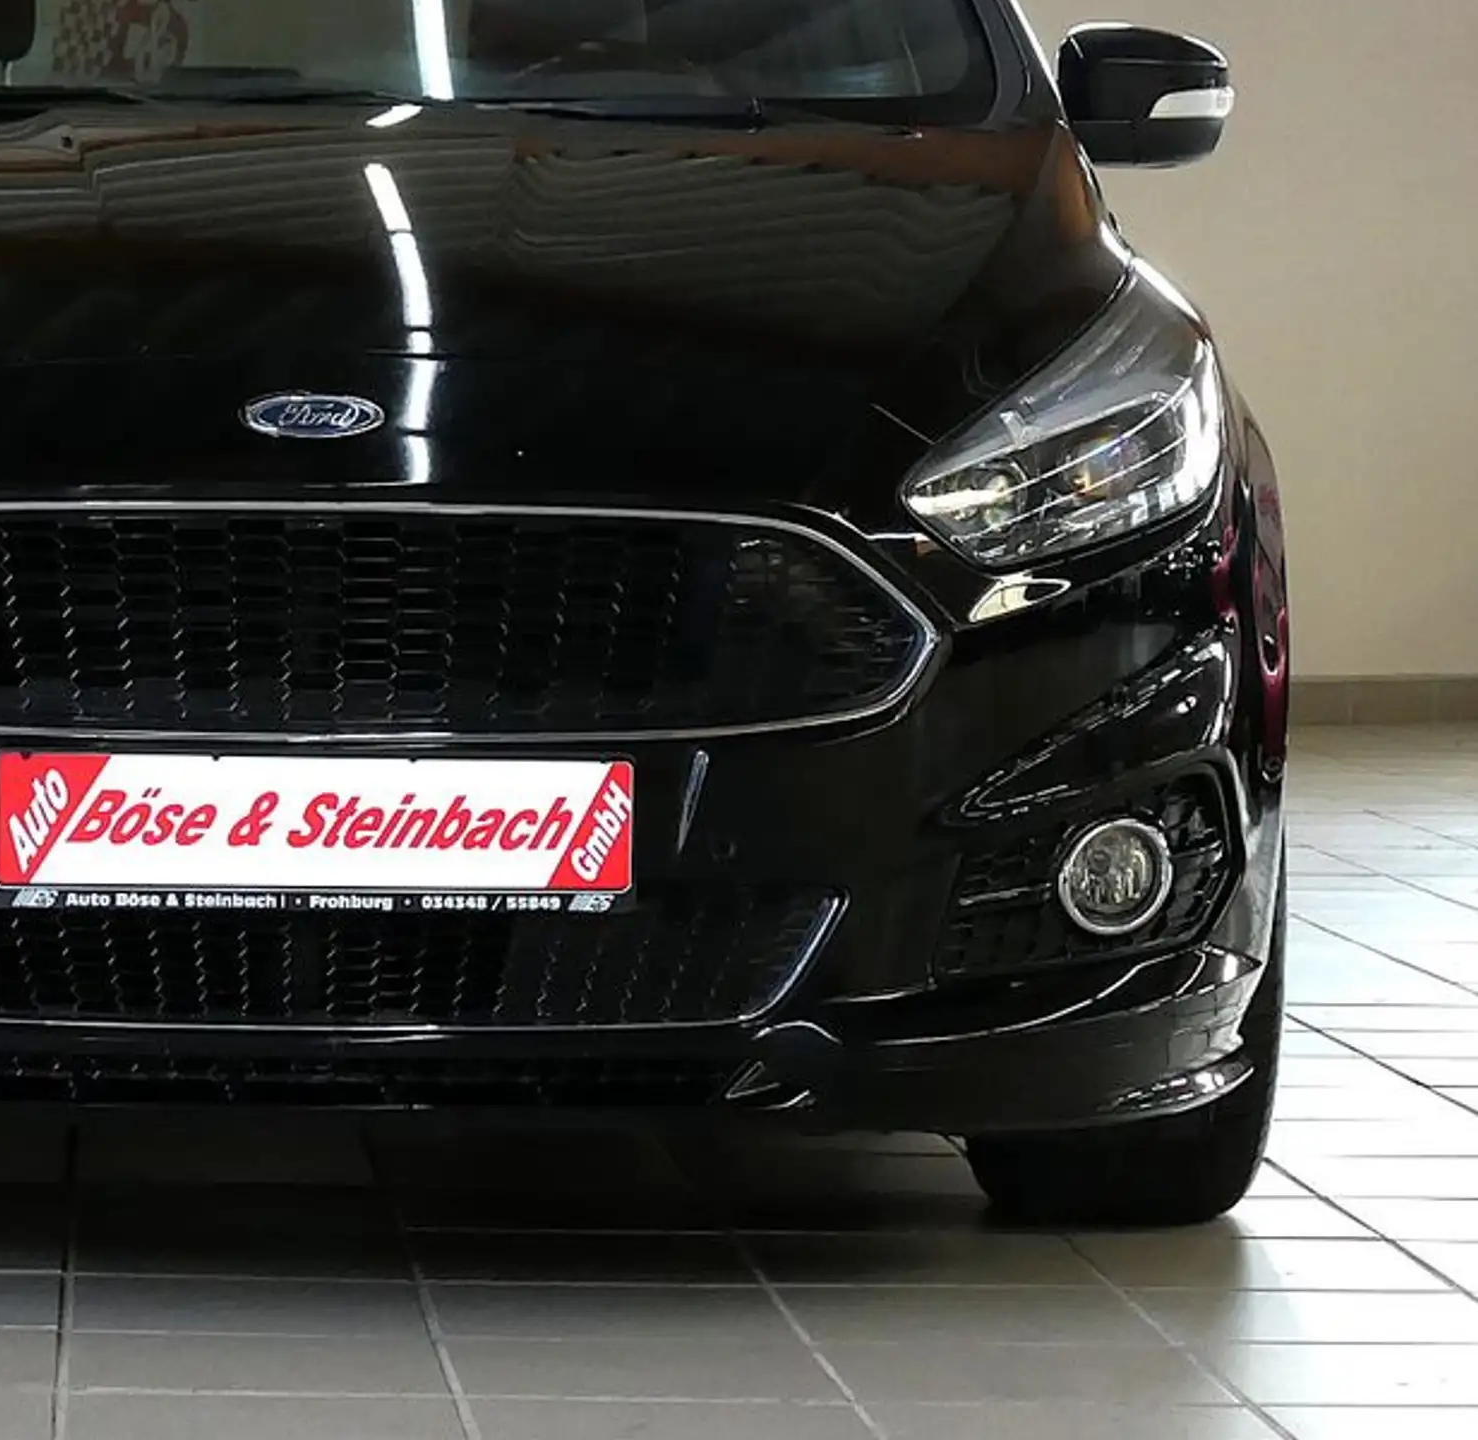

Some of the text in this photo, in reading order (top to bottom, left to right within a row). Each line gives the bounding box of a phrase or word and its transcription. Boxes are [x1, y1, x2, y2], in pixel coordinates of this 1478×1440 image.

[278, 402, 359, 428] Ford
[9, 768, 632, 882] Auto Böse & Steinbach GmbH
[65, 892, 110, 907] Auto
[115, 891, 163, 907] Böse
[166, 892, 178, 907] &
[184, 891, 277, 908] Steinbach
[310, 894, 394, 911] Frohburg
